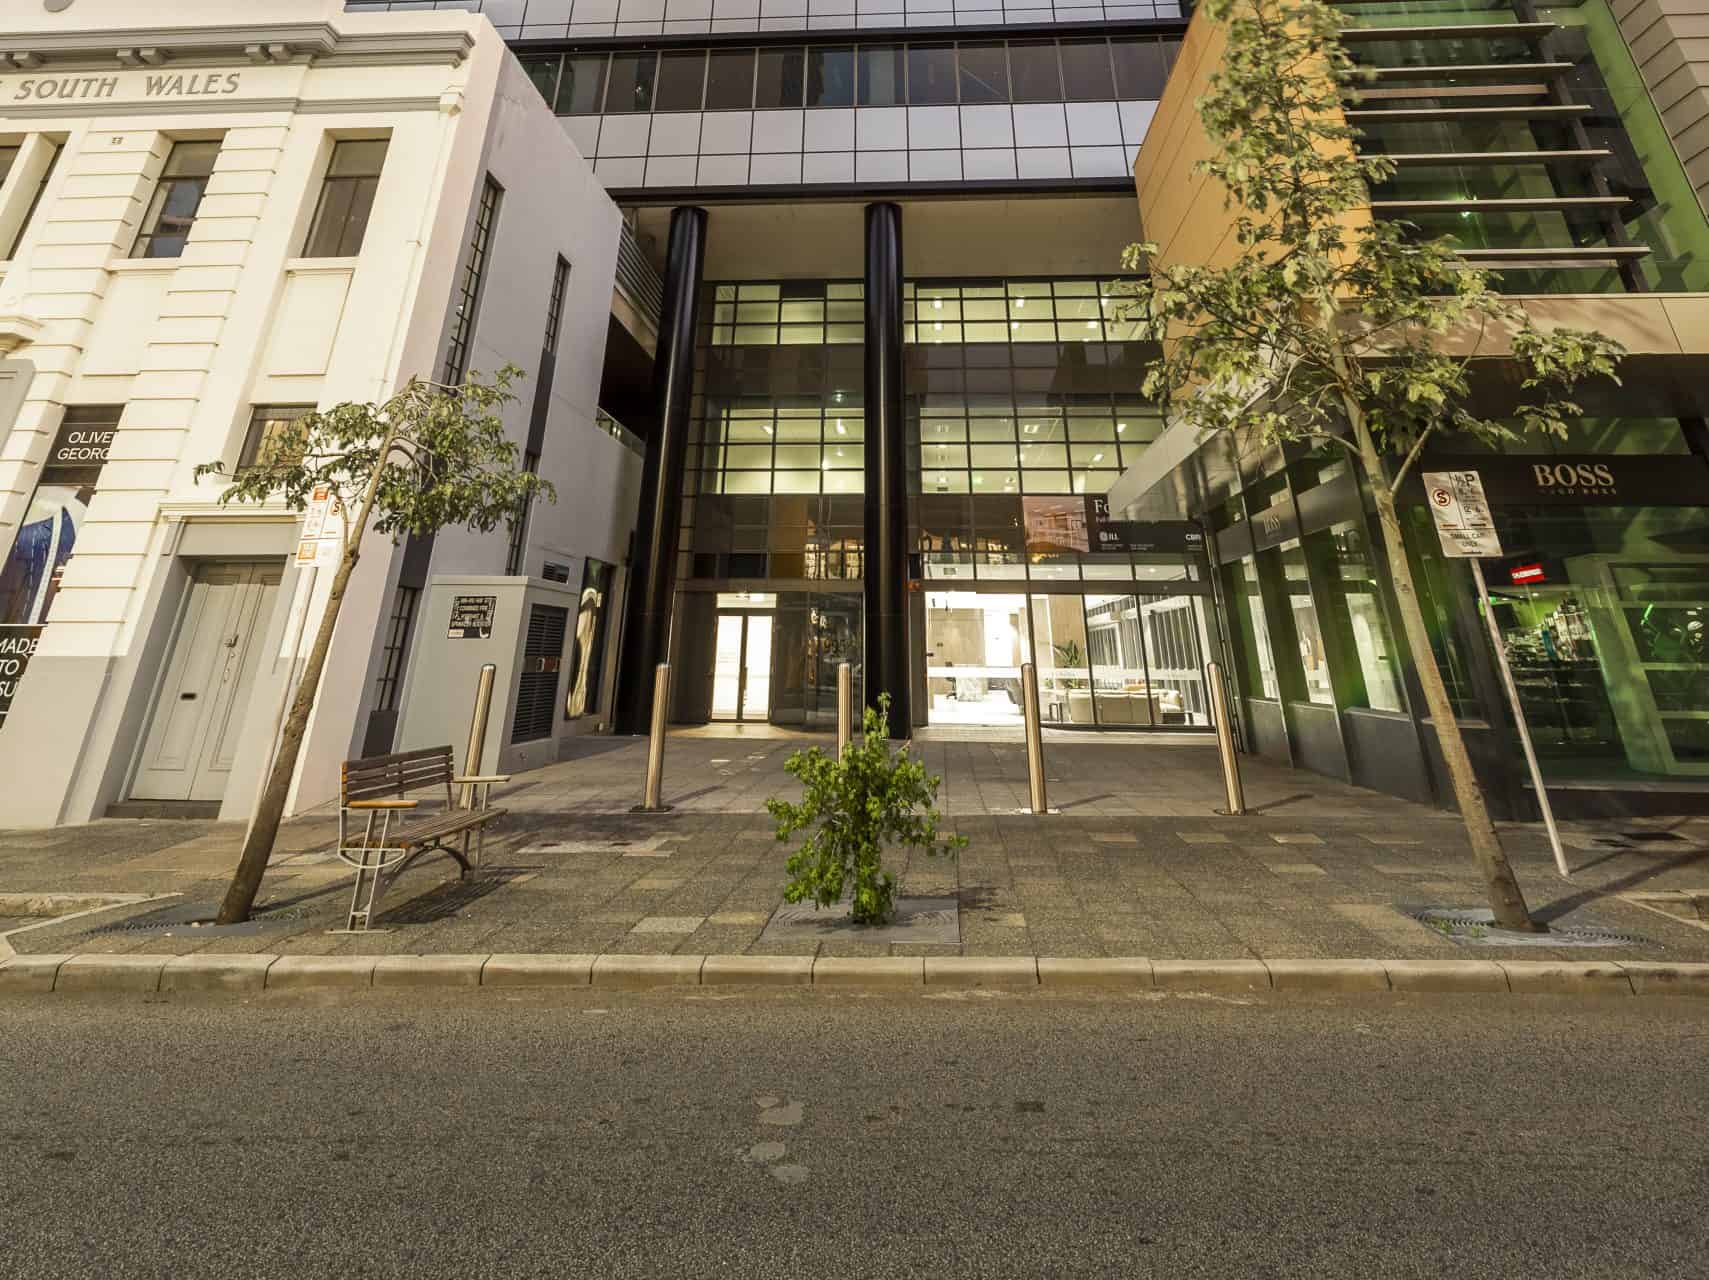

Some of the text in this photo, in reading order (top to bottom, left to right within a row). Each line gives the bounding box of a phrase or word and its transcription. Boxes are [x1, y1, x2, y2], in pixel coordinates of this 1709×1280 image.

[14, 72, 241, 100] SOUTH WALES
[1533, 463, 1615, 487] BOSS
